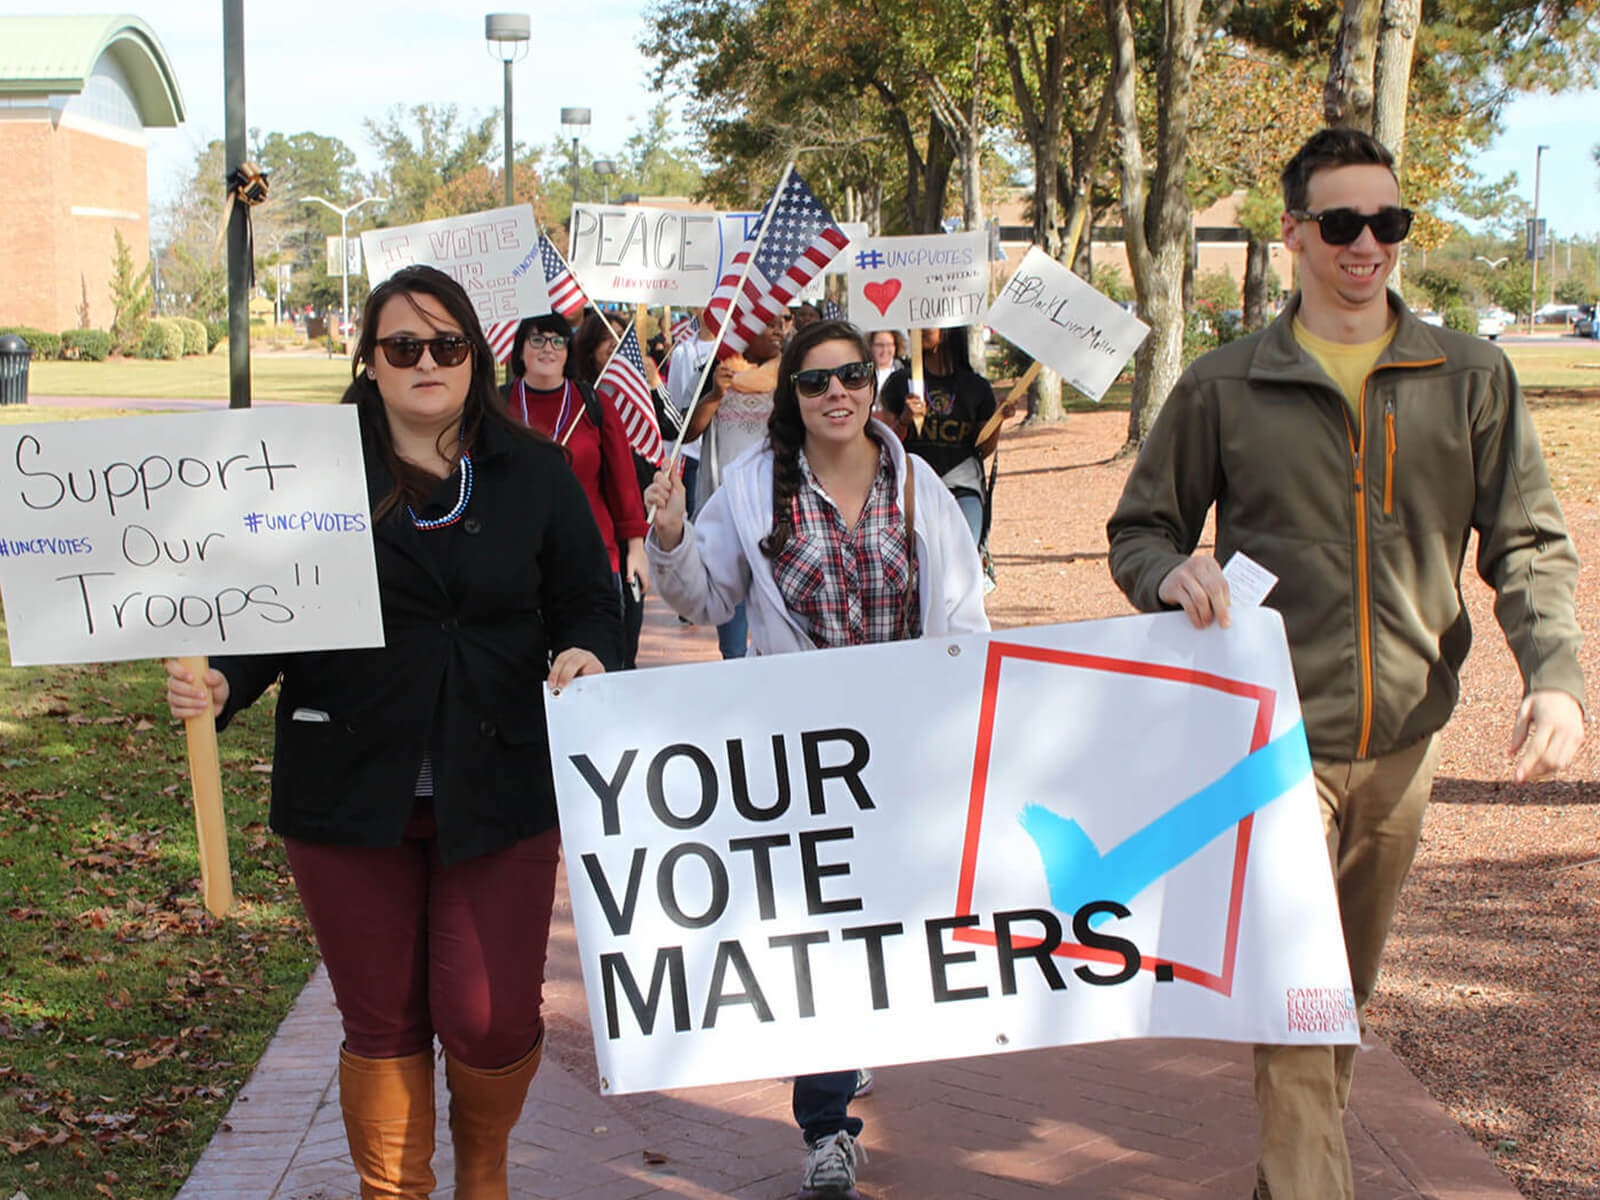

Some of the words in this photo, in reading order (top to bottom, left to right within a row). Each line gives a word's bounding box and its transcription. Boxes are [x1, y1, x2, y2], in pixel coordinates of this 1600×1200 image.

[428, 218, 521, 260] VOTE
[570, 209, 714, 271] PEACE
[908, 291, 985, 322] EQUALITY
[925, 419, 970, 441] NCP
[16, 434, 297, 517] Support
[243, 512, 367, 534] #UNCPVOTES
[0, 536, 93, 557] #UNCPVOTES
[122, 524, 225, 567] Our
[569, 727, 877, 836] YOUR
[581, 826, 864, 937] VOTE
[599, 900, 1175, 1041] MATTERS.
[1286, 988, 1344, 1000] CAMPUS
[1287, 999, 1345, 1011] ELECTION
[1288, 1021, 1345, 1033] PROJECT
